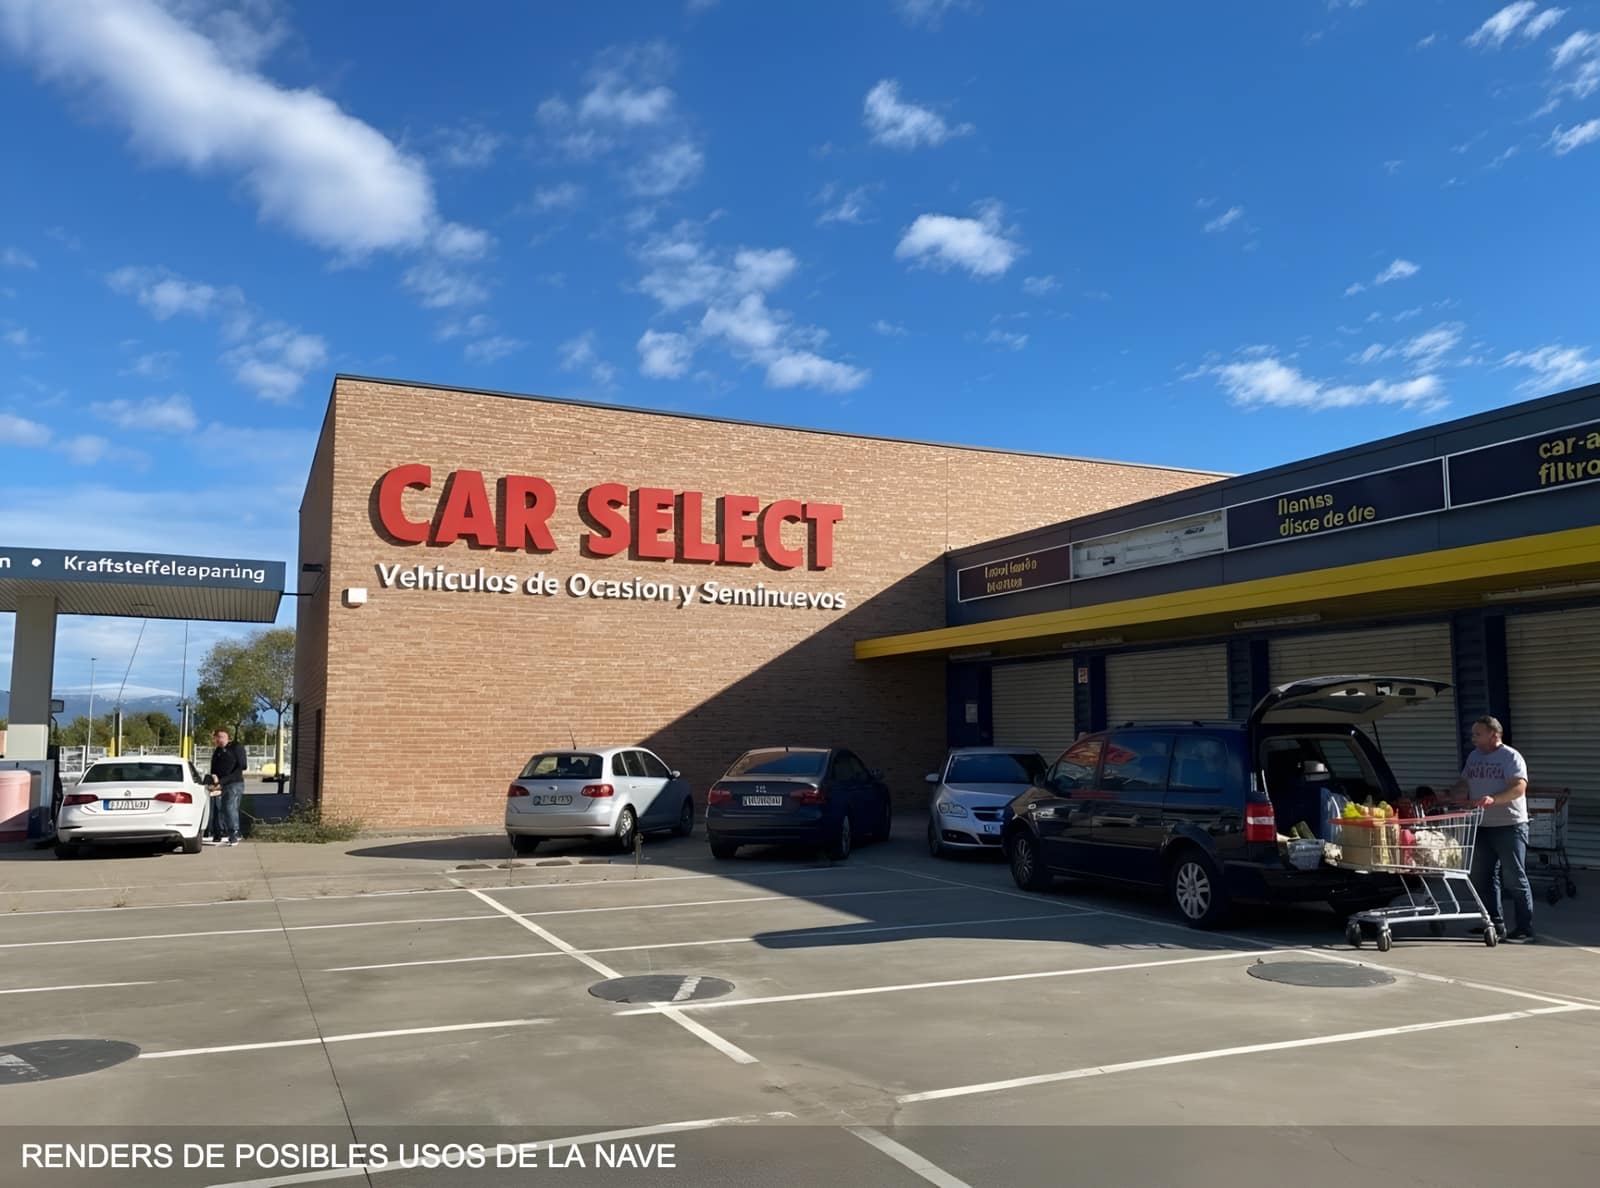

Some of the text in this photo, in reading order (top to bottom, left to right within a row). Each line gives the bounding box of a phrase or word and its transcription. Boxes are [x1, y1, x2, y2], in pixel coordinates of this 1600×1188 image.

[374, 463, 843, 569] CAR SELECT
[1323, 510, 1344, 528] de
[525, 571, 559, 594] de
[569, 572, 674, 600] Ocasion
[679, 583, 697, 606] y
[700, 581, 848, 610] Seminuevos
